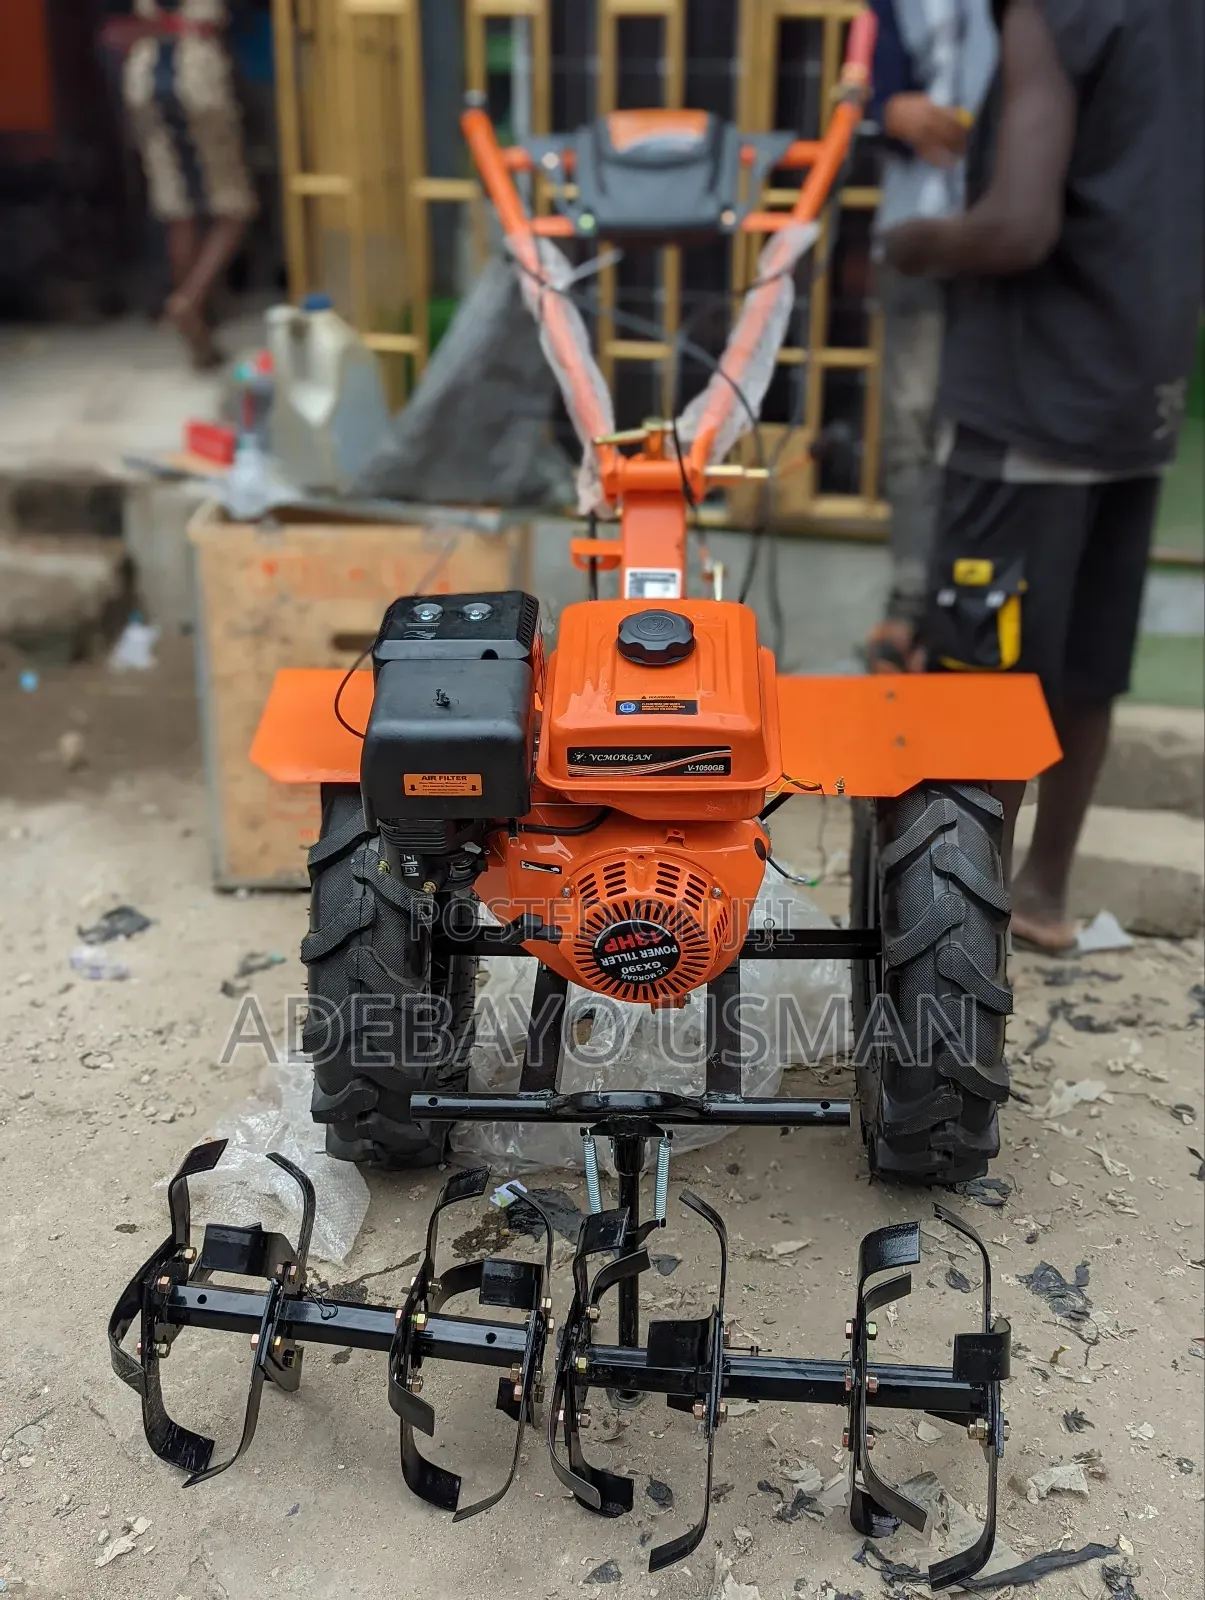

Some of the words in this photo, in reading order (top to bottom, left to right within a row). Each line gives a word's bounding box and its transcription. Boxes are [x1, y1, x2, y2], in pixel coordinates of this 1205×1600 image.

[589, 753, 652, 762] VCMORGAN
[605, 930, 662, 952] 13HP
[639, 944, 678, 958] POWER
[600, 952, 638, 966] TILLER
[621, 961, 661, 974] GX390
[621, 972, 656, 980] MORGAN
